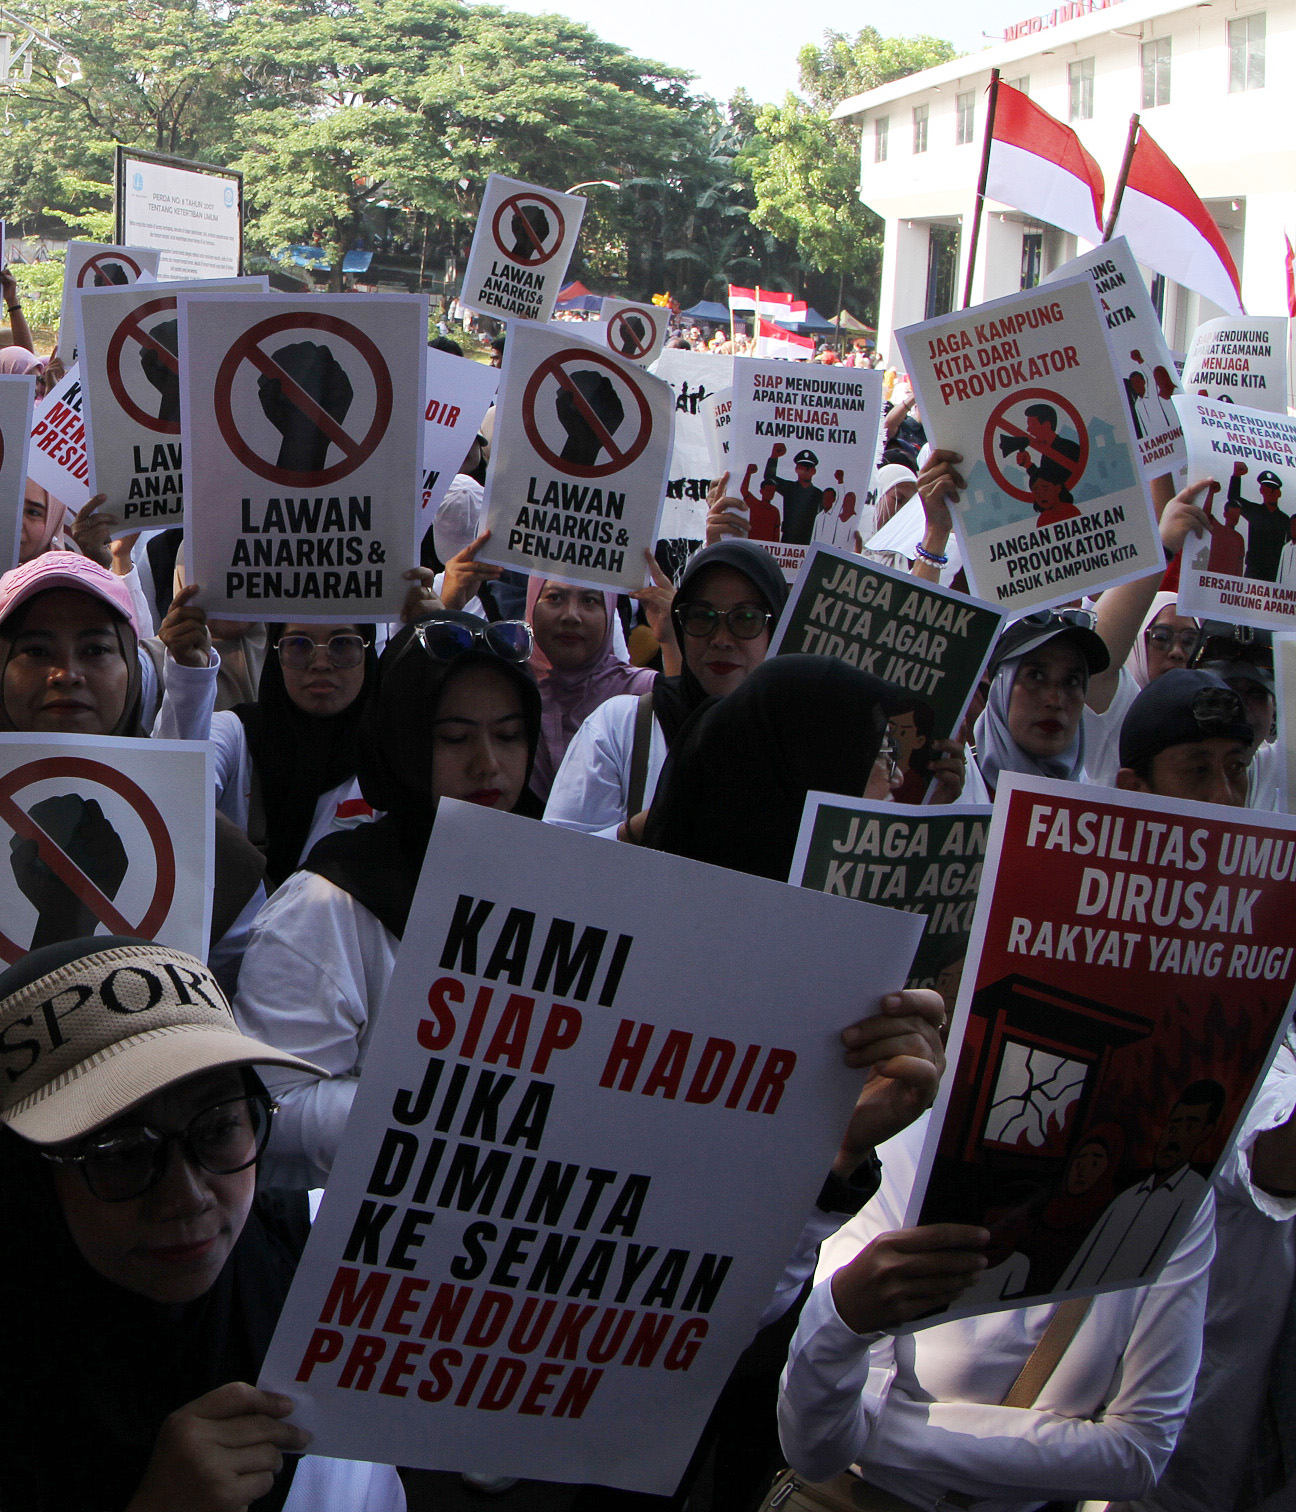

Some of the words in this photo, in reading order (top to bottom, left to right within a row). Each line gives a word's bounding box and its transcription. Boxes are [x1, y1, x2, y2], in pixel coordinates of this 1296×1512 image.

[148, 203, 173, 214] TENTANG
[483, 277, 537, 305] ANARKIS
[536, 294, 544, 305] &
[491, 261, 545, 291] LAWAN
[928, 330, 973, 360] JAGA
[974, 302, 1064, 345] KAMPUNG
[1105, 305, 1136, 329] KITA
[1213, 330, 1269, 343] MENDUKUNG
[933, 351, 976, 381] KITA
[978, 339, 1020, 368] DARI
[1201, 357, 1250, 372] MENJAGA
[1221, 344, 1271, 357] KEAMANAN
[753, 374, 783, 388] SIAP
[785, 377, 863, 397] MENDUKUNG
[939, 346, 1080, 406] PROVOKATOR
[1241, 374, 1266, 389] KITA
[425, 399, 461, 428] DIR
[752, 389, 799, 405] APARAT
[800, 394, 865, 412] KEAMANAN
[774, 407, 839, 426] MENJAGA
[1196, 405, 1226, 420] SIAP
[1228, 412, 1296, 434] MENDUKUN
[755, 421, 825, 442] KAMPUNG
[828, 428, 857, 445] KITA
[1201, 416, 1246, 433] APARAT
[1249, 426, 1296, 443] KEAMAN
[1227, 431, 1294, 455] MENJAGA
[30, 420, 90, 488] PRESID
[1142, 443, 1175, 465] APARAT
[1211, 440, 1283, 465] KAMPUNG
[240, 496, 372, 534] LAWAN
[526, 476, 626, 520] LAWAN
[515, 506, 614, 544] ANARKIS
[615, 527, 630, 547] &
[989, 528, 1051, 563] JANGAN
[1053, 505, 1125, 541] BIARKAN
[231, 536, 363, 567] ANARKIS
[367, 540, 386, 565] &
[507, 529, 624, 573] PENJARAH
[782, 547, 805, 558] JAGA
[1007, 529, 1118, 578] PROVOKATOR
[225, 570, 383, 599] PENJARAH
[996, 575, 1044, 601] MASUK
[1045, 554, 1110, 585] KAMPUNG
[1111, 543, 1139, 565] KITA
[1199, 576, 1244, 593] BERSATU
[1245, 583, 1270, 598] JAGA
[822, 564, 893, 611] JAGA
[898, 591, 976, 638] ANAK
[1220, 593, 1262, 611] DUKUNG
[1264, 600, 1296, 616] APARA
[809, 593, 873, 640] KITA
[876, 620, 948, 664] AGAR
[801, 624, 882, 673] TIDAK
[882, 655, 946, 696] IKUT
[832, 817, 929, 858] JAGA
[1026, 804, 1210, 871] FASILITAS
[1217, 833, 1296, 882] UMU
[823, 860, 908, 899] KITA
[914, 862, 983, 898] AGA
[1076, 867, 1262, 935] DIRUSAK
[439, 894, 634, 1008] KAMI
[1007, 916, 1142, 969] RAKYAT
[1148, 936, 1224, 977] YANG
[1226, 944, 1295, 980] RUGI
[416, 976, 583, 1075] SIAP
[598, 1018, 797, 1115] HADIR
[392, 1057, 555, 1151] JIKA
[366, 1127, 652, 1237] DIMINTA
[342, 1199, 435, 1272] KE
[449, 1220, 734, 1314] SENAYAN
[318, 1266, 710, 1372] MENDUKUNG
[295, 1328, 604, 1419] PRESIDEN
